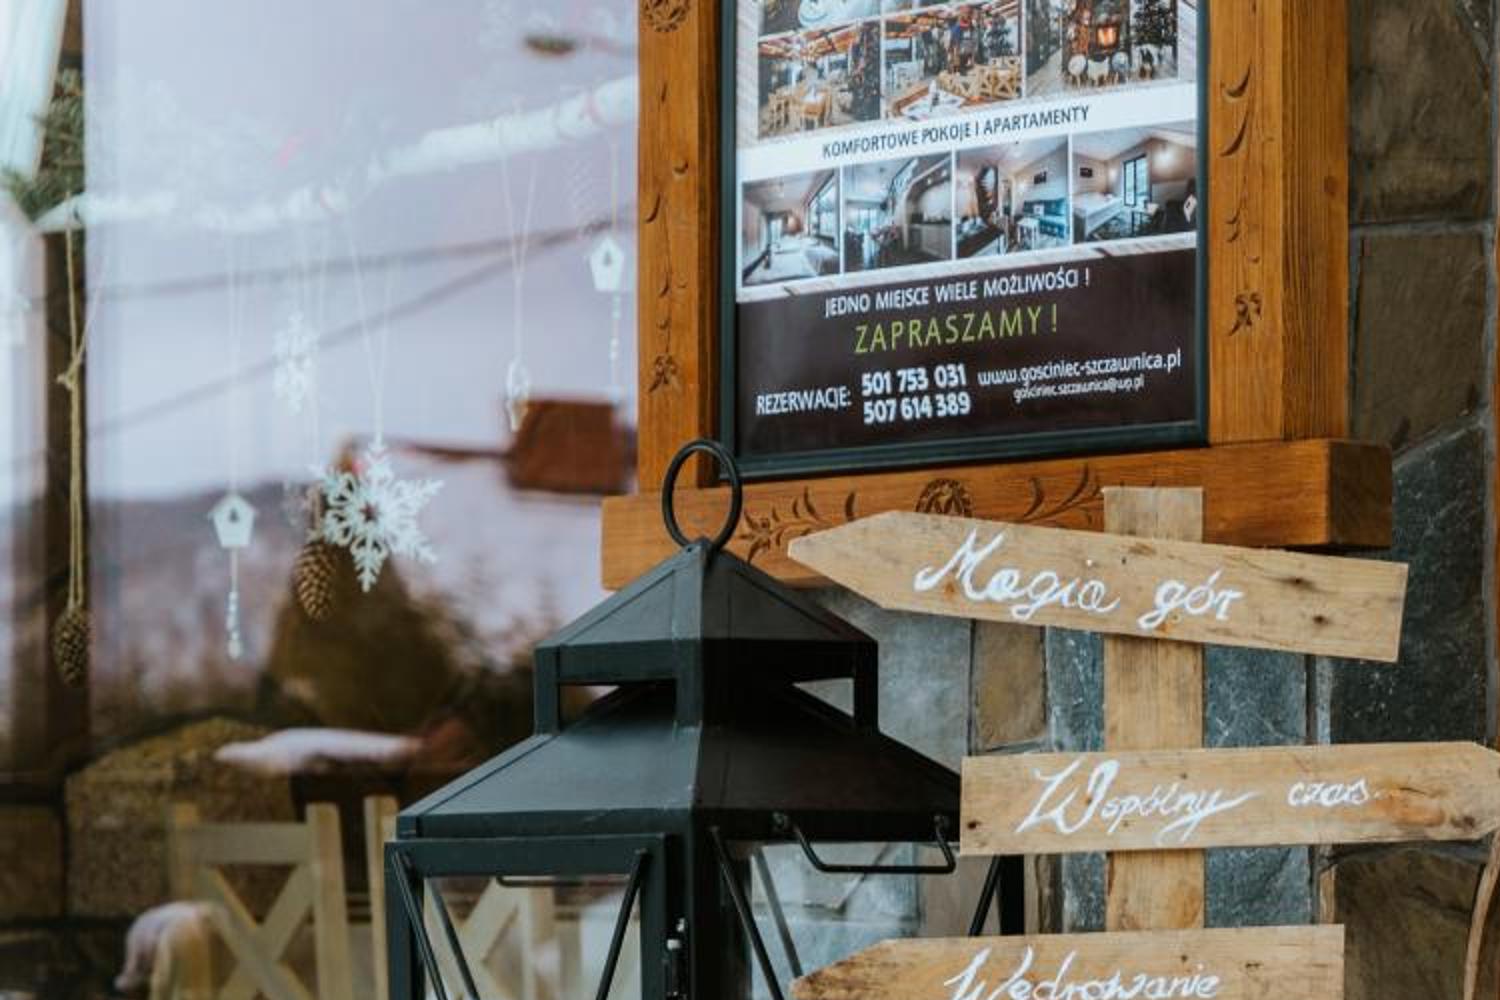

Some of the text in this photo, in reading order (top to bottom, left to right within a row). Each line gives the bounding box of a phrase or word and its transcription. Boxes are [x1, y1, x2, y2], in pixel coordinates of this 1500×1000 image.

[823, 104, 1090, 158] KOMFORTOWE POKOJE I APARTAMENTY
[825, 293, 871, 319] JEDNO
[875, 286, 930, 311] MIEJSCE
[935, 280, 978, 301] WIELE
[983, 266, 1079, 299] MOŻLIWOŚCI
[854, 305, 1042, 354] ZAPRASZAMY
[755, 385, 853, 416] REZERWACJE:
[861, 363, 967, 397] 501 753 031
[863, 391, 971, 424] 507 614 389
[913, 528, 1244, 630] Magia gór
